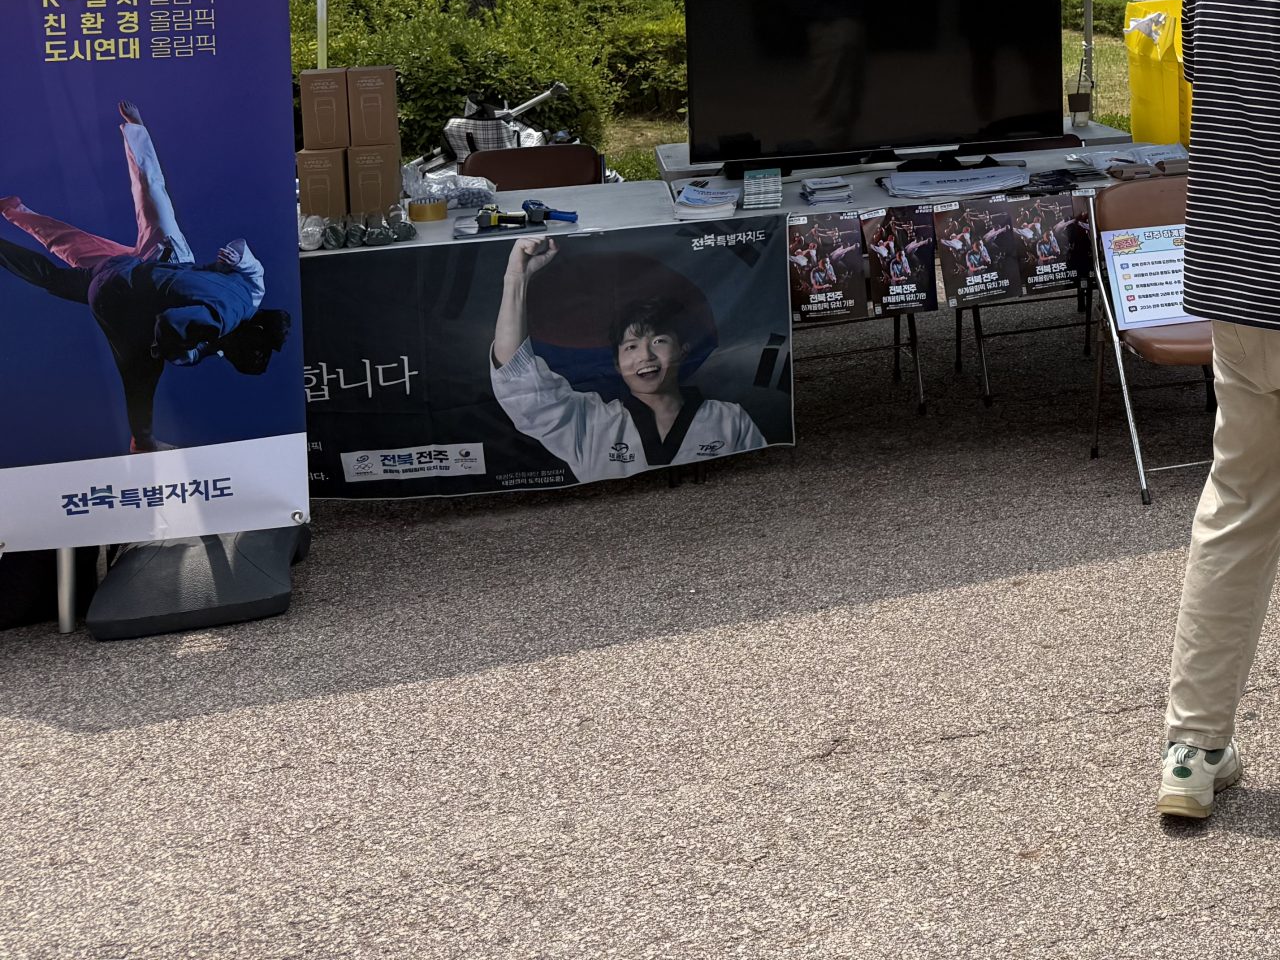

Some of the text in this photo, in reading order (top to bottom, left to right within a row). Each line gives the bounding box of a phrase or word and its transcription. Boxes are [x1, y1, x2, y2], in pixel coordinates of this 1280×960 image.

[149, 9, 216, 32] 올림픽
[44, 35, 217, 63] 도시연대 올림픽
[691, 229, 766, 251] 전북특별자치도
[380, 449, 450, 467] 전북 전주
[61, 477, 235, 516] 전북특별자치도
